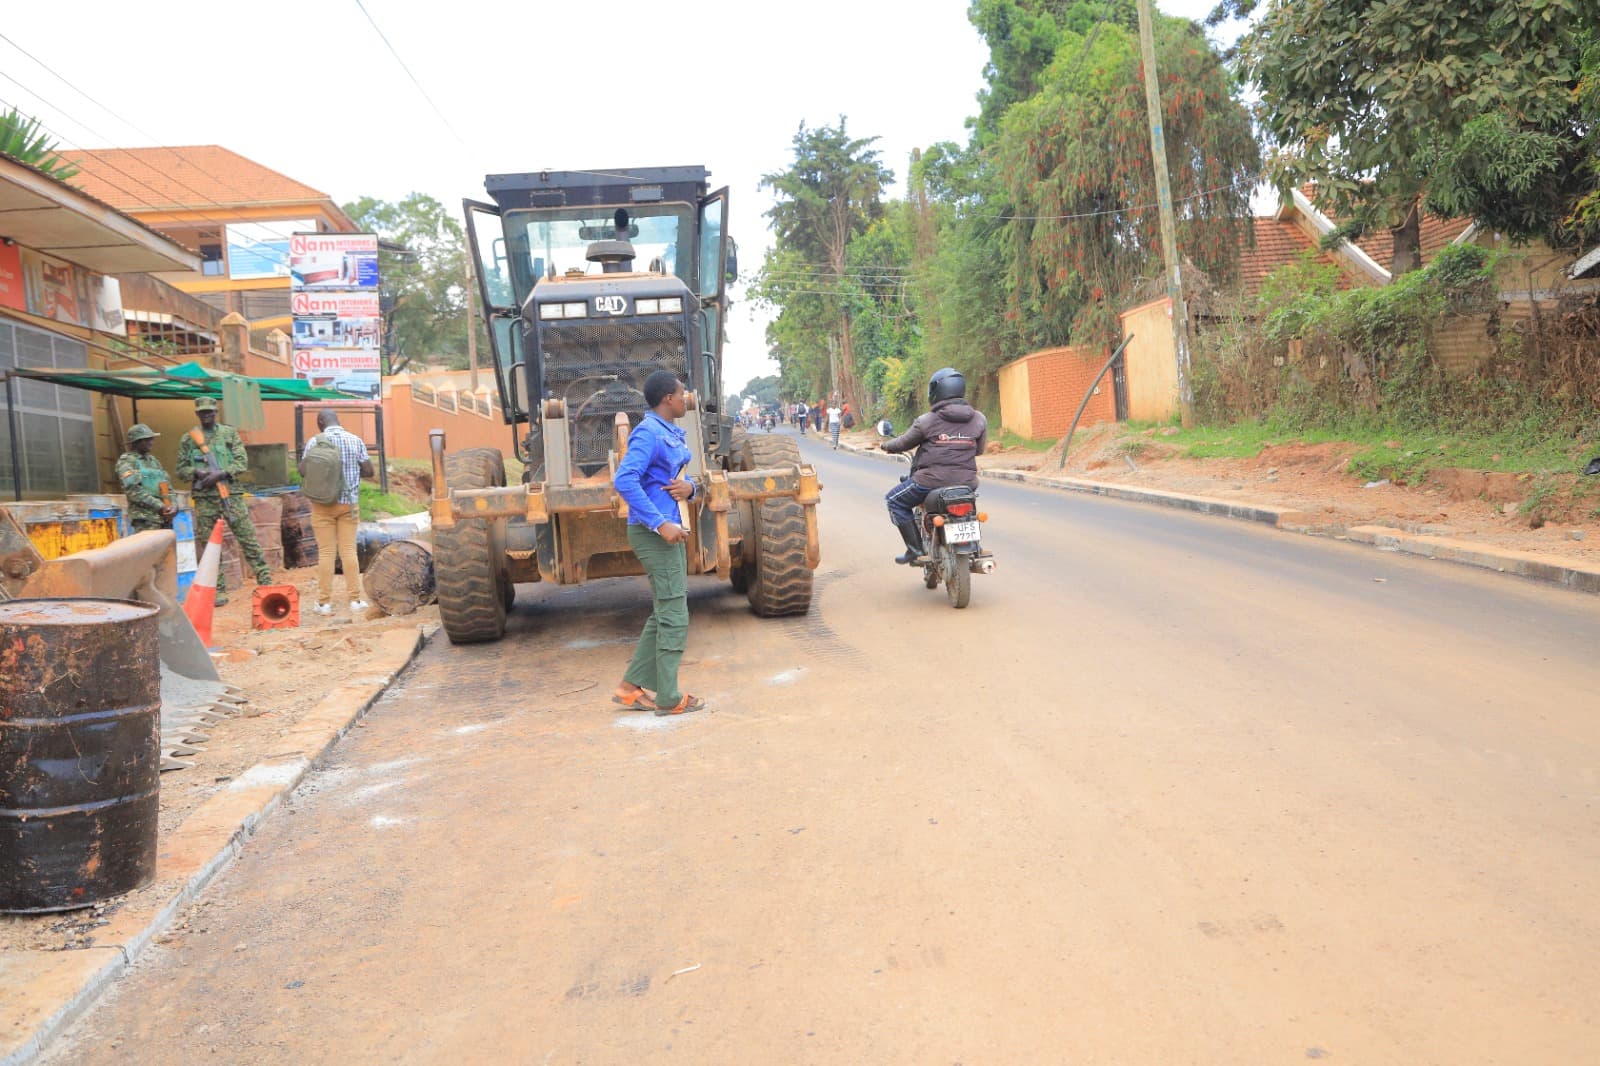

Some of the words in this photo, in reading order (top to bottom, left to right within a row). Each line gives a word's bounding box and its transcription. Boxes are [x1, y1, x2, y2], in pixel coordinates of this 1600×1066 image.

[291, 234, 335, 255] Nam
[293, 293, 337, 314] Nam
[596, 296, 624, 314] CAT
[295, 351, 339, 371] Nam
[958, 522, 975, 532] UFS
